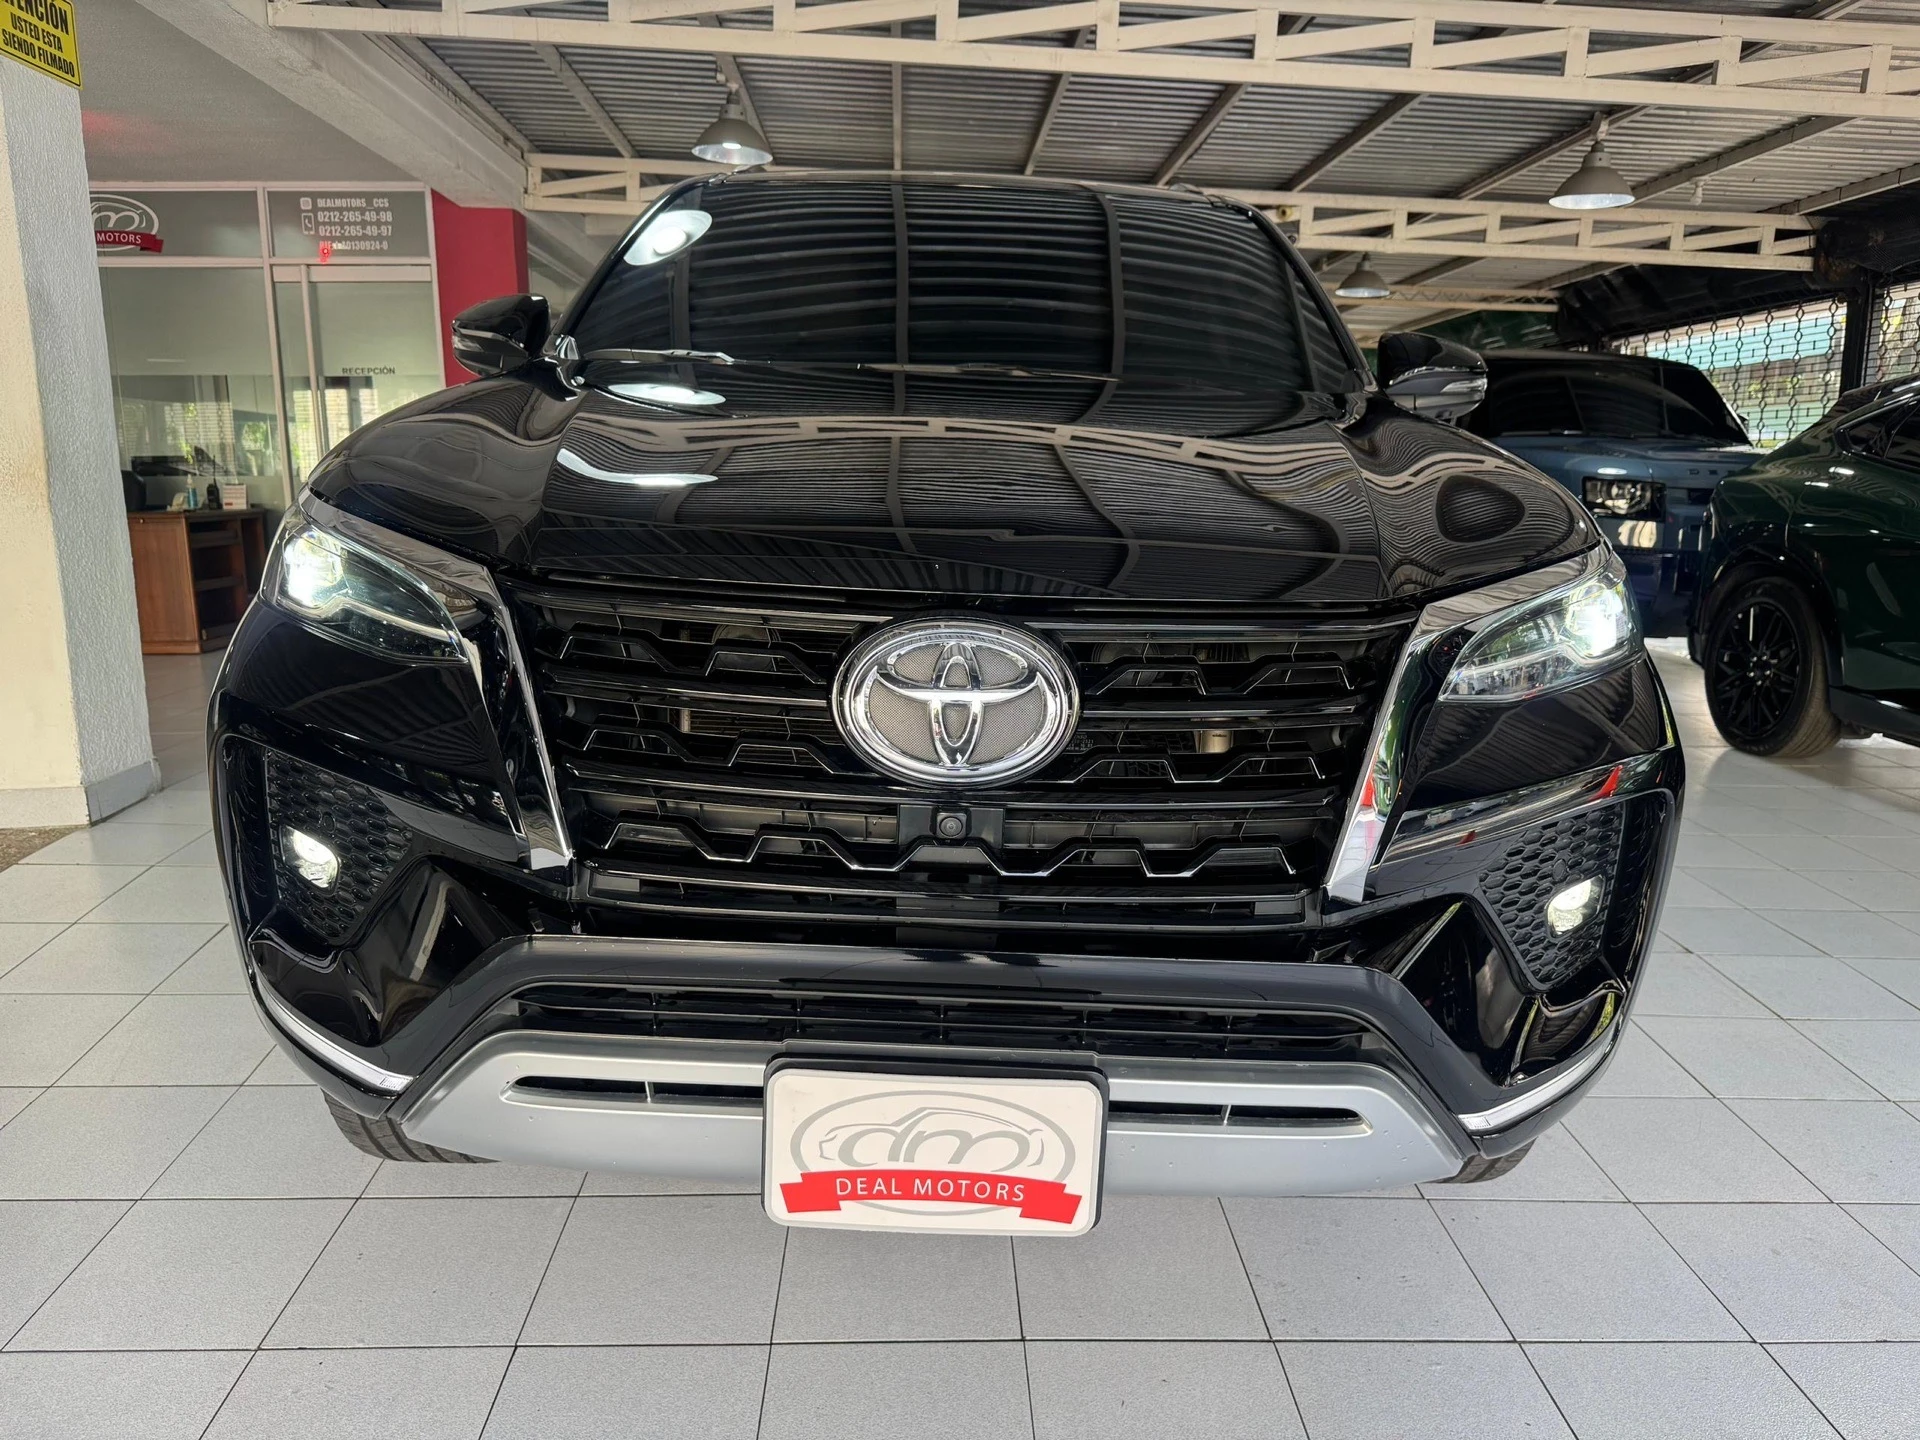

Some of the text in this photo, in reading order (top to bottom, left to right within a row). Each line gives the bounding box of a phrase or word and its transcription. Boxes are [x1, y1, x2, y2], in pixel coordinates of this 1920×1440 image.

[5, 0, 69, 35] NCIÓN
[10, 12, 63, 53] USTED ESTA
[2, 28, 75, 77] SIENDO FILMADO
[317, 211, 392, 222] 0212-265-49-98
[96, 232, 142, 244] MOTORS
[318, 225, 392, 236] 0212-265-49-97
[341, 364, 396, 375] RECEPCIÓN
[835, 1177, 1025, 1202] DEAL MOTORS
